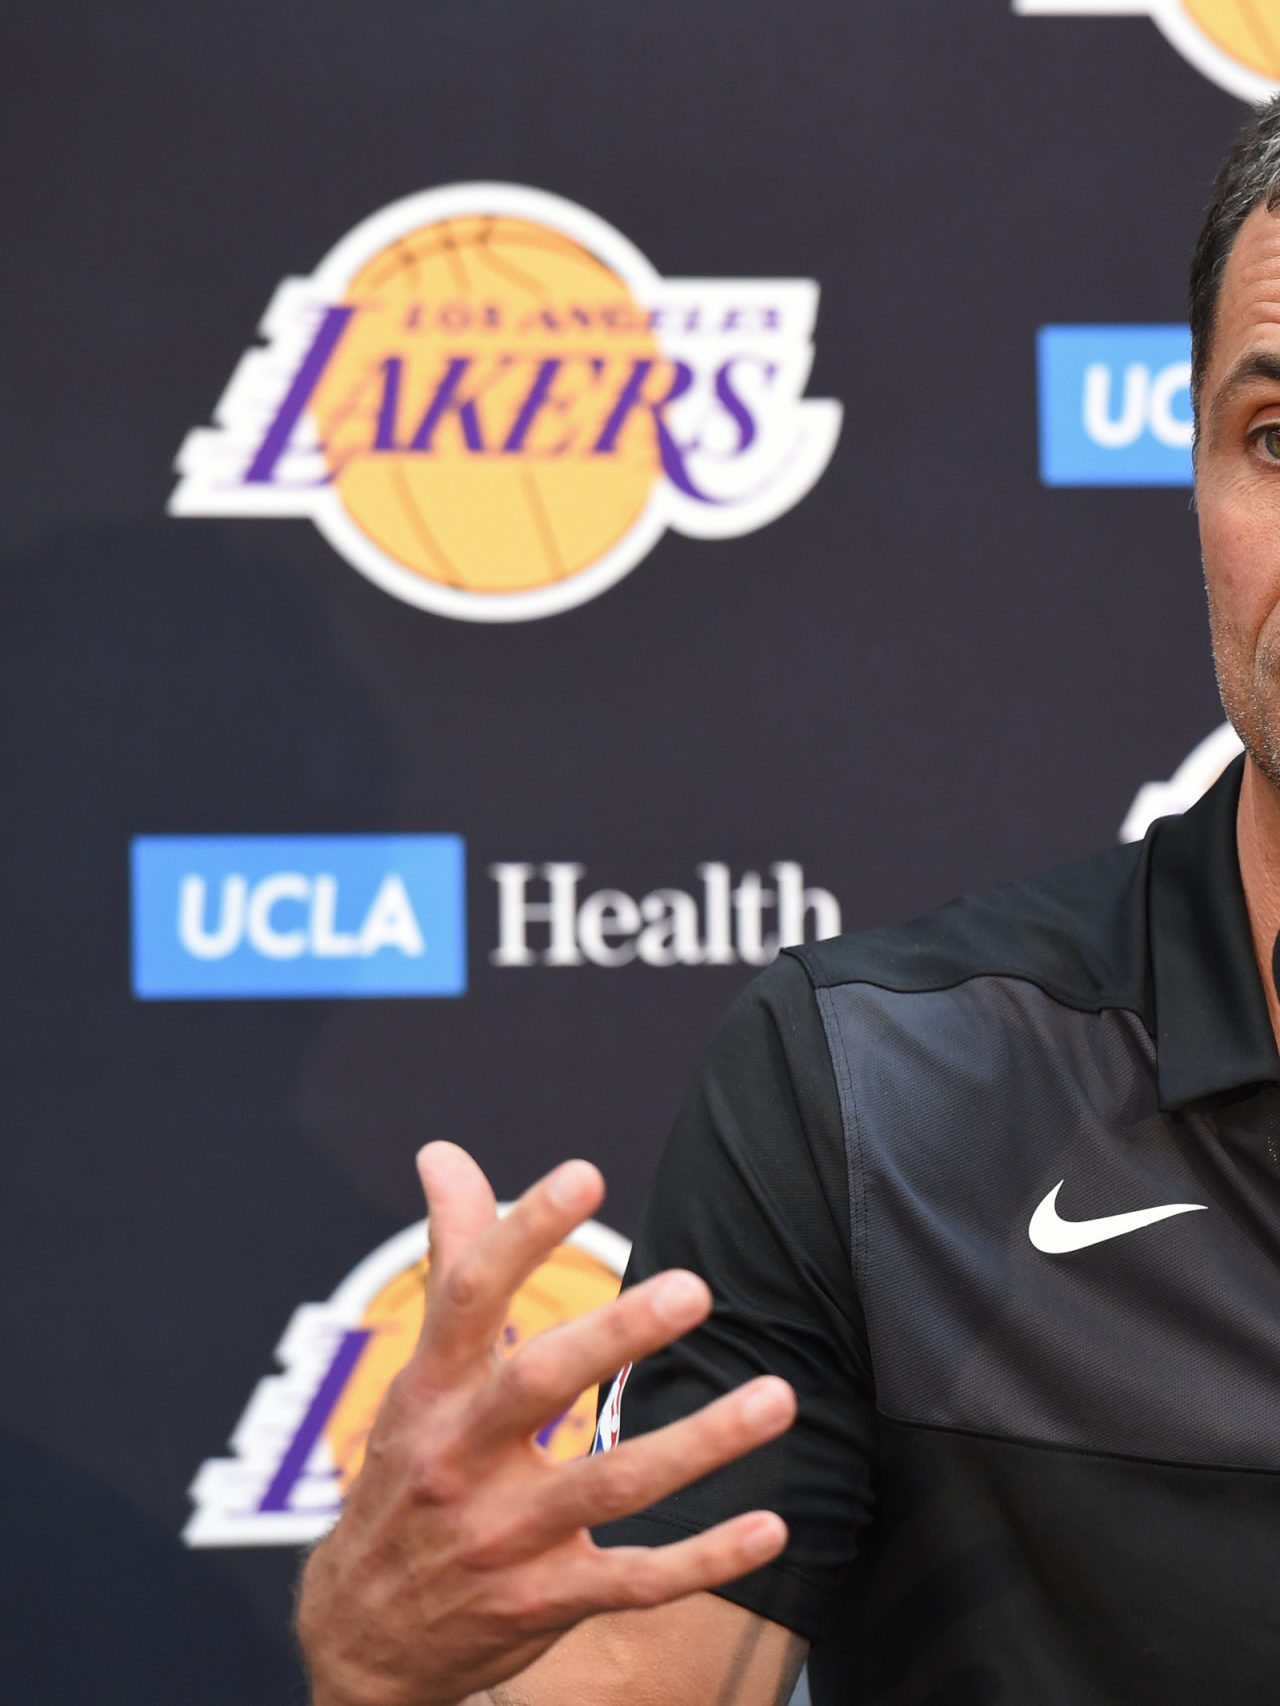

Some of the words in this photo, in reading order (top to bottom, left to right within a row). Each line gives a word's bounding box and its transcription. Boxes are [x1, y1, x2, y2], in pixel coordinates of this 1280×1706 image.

[225, 303, 788, 505] LAKERS
[175, 871, 426, 960] UCLA
[490, 859, 843, 967] Health
